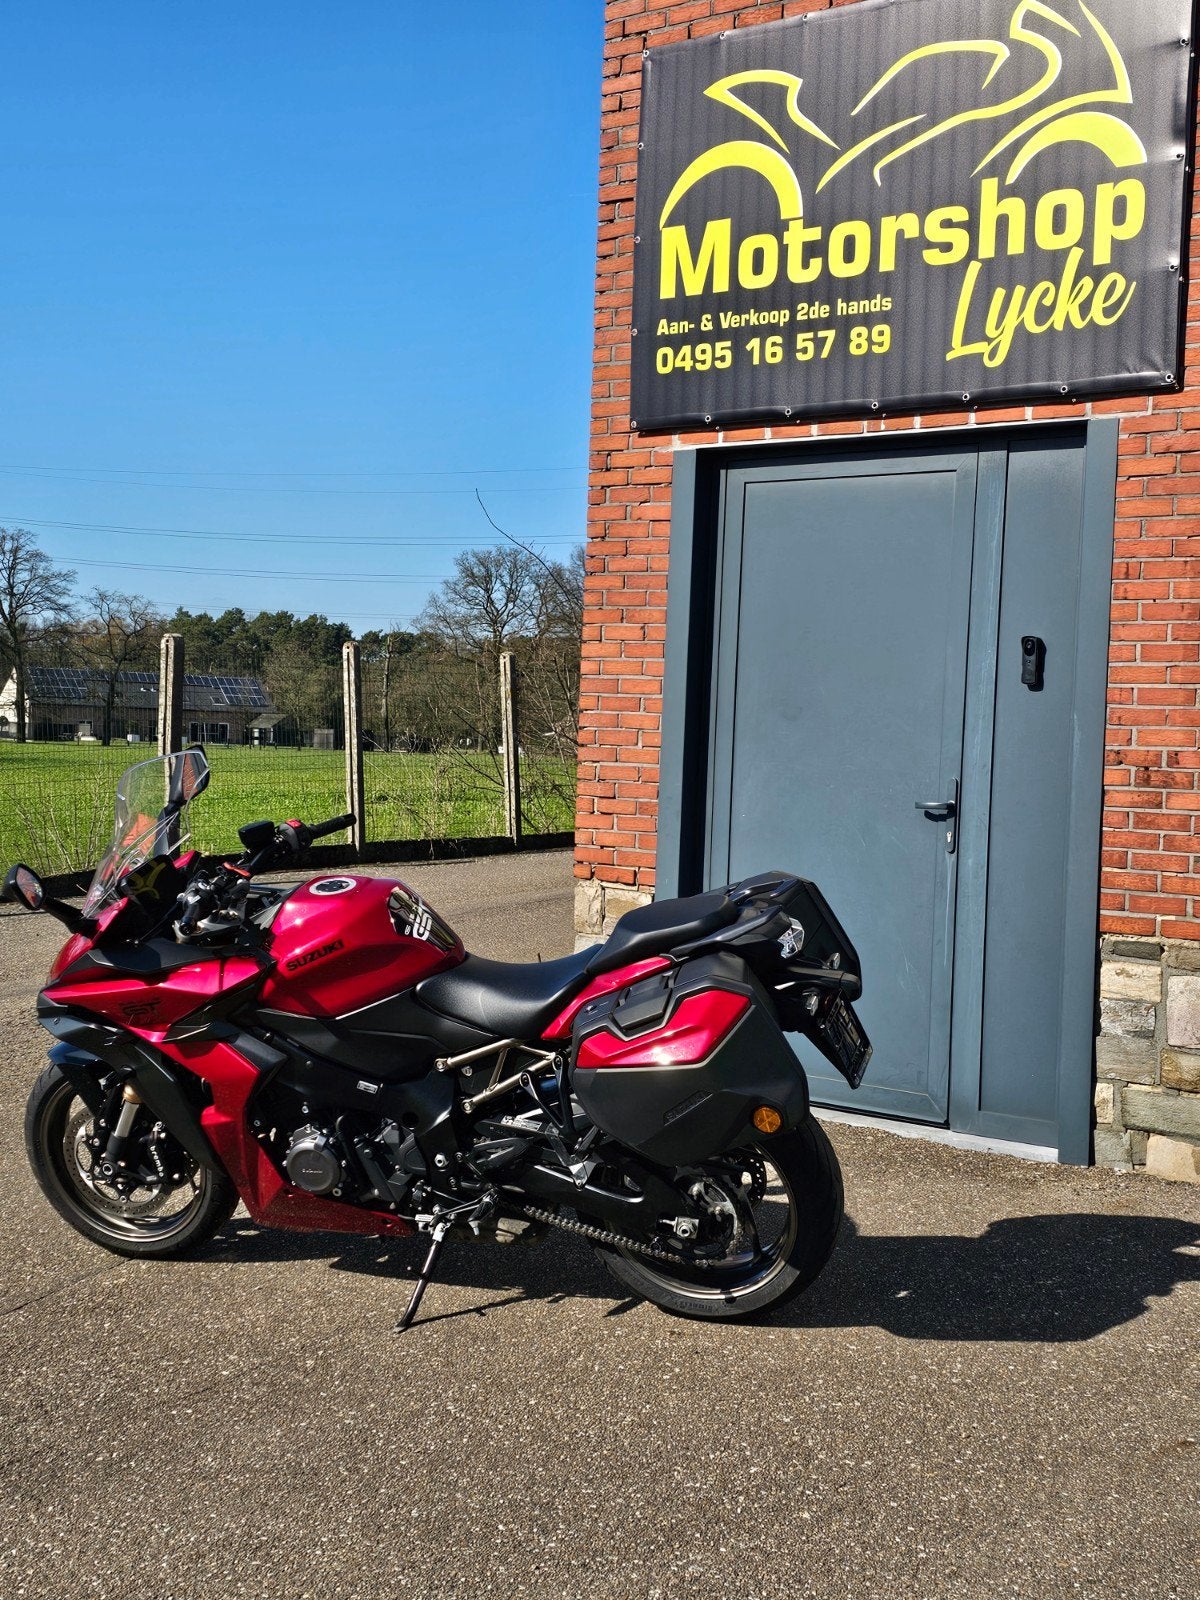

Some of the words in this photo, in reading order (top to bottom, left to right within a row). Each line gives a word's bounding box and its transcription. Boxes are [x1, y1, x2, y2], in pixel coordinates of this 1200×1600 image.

[659, 177, 1146, 299] Motorshop
[656, 318, 695, 336] Aan-
[700, 313, 713, 332] &
[719, 308, 790, 328] Verkoop
[796, 301, 830, 321] 2de
[837, 294, 892, 316] hands
[946, 246, 1137, 368] Lycke
[655, 340, 732, 375] 0495
[745, 335, 783, 366] 16
[795, 329, 836, 361] 57
[849, 323, 892, 356] 89
[286, 939, 344, 971] SUZUKI
[150, 1145, 164, 1177] brembo
